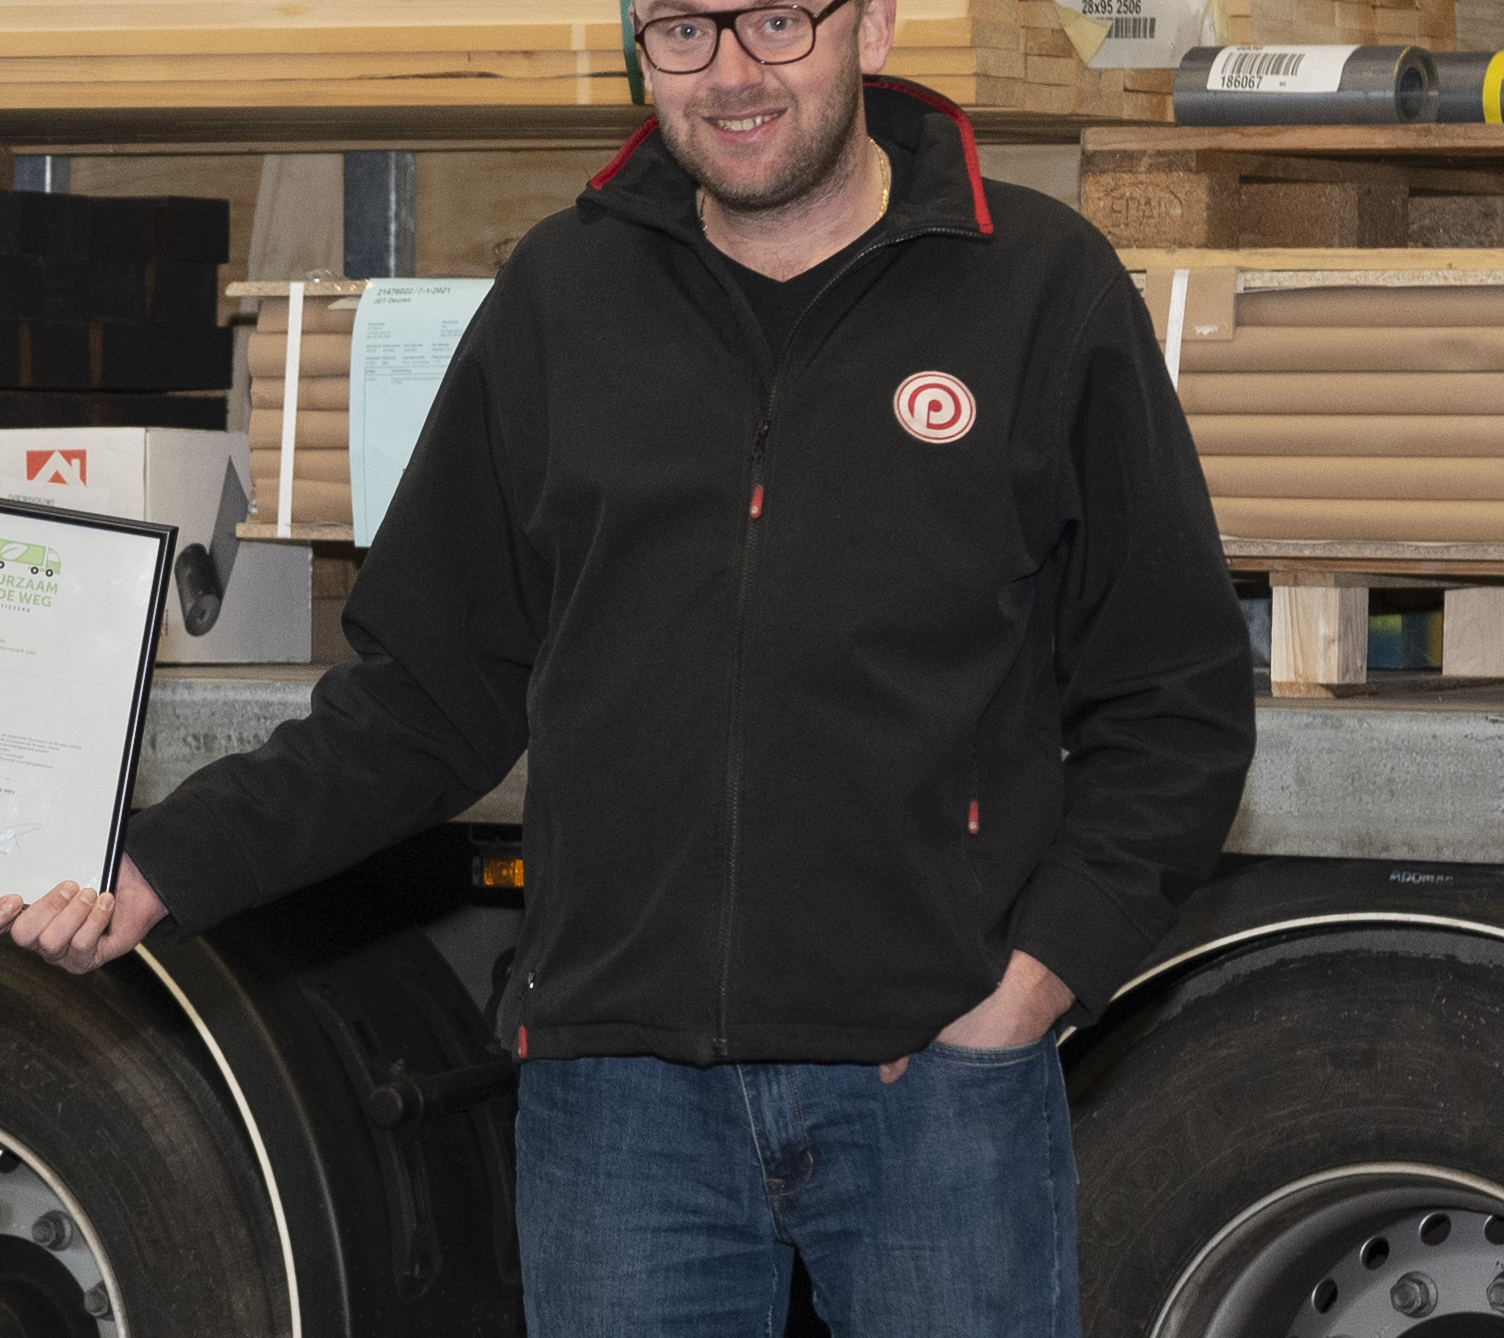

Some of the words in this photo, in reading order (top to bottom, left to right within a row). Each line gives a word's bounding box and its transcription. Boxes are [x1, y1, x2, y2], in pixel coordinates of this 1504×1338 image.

[1116, 0, 1142, 14] 2506
[1221, 76, 1263, 90] 186067
[18, 591, 52, 608] WEG
